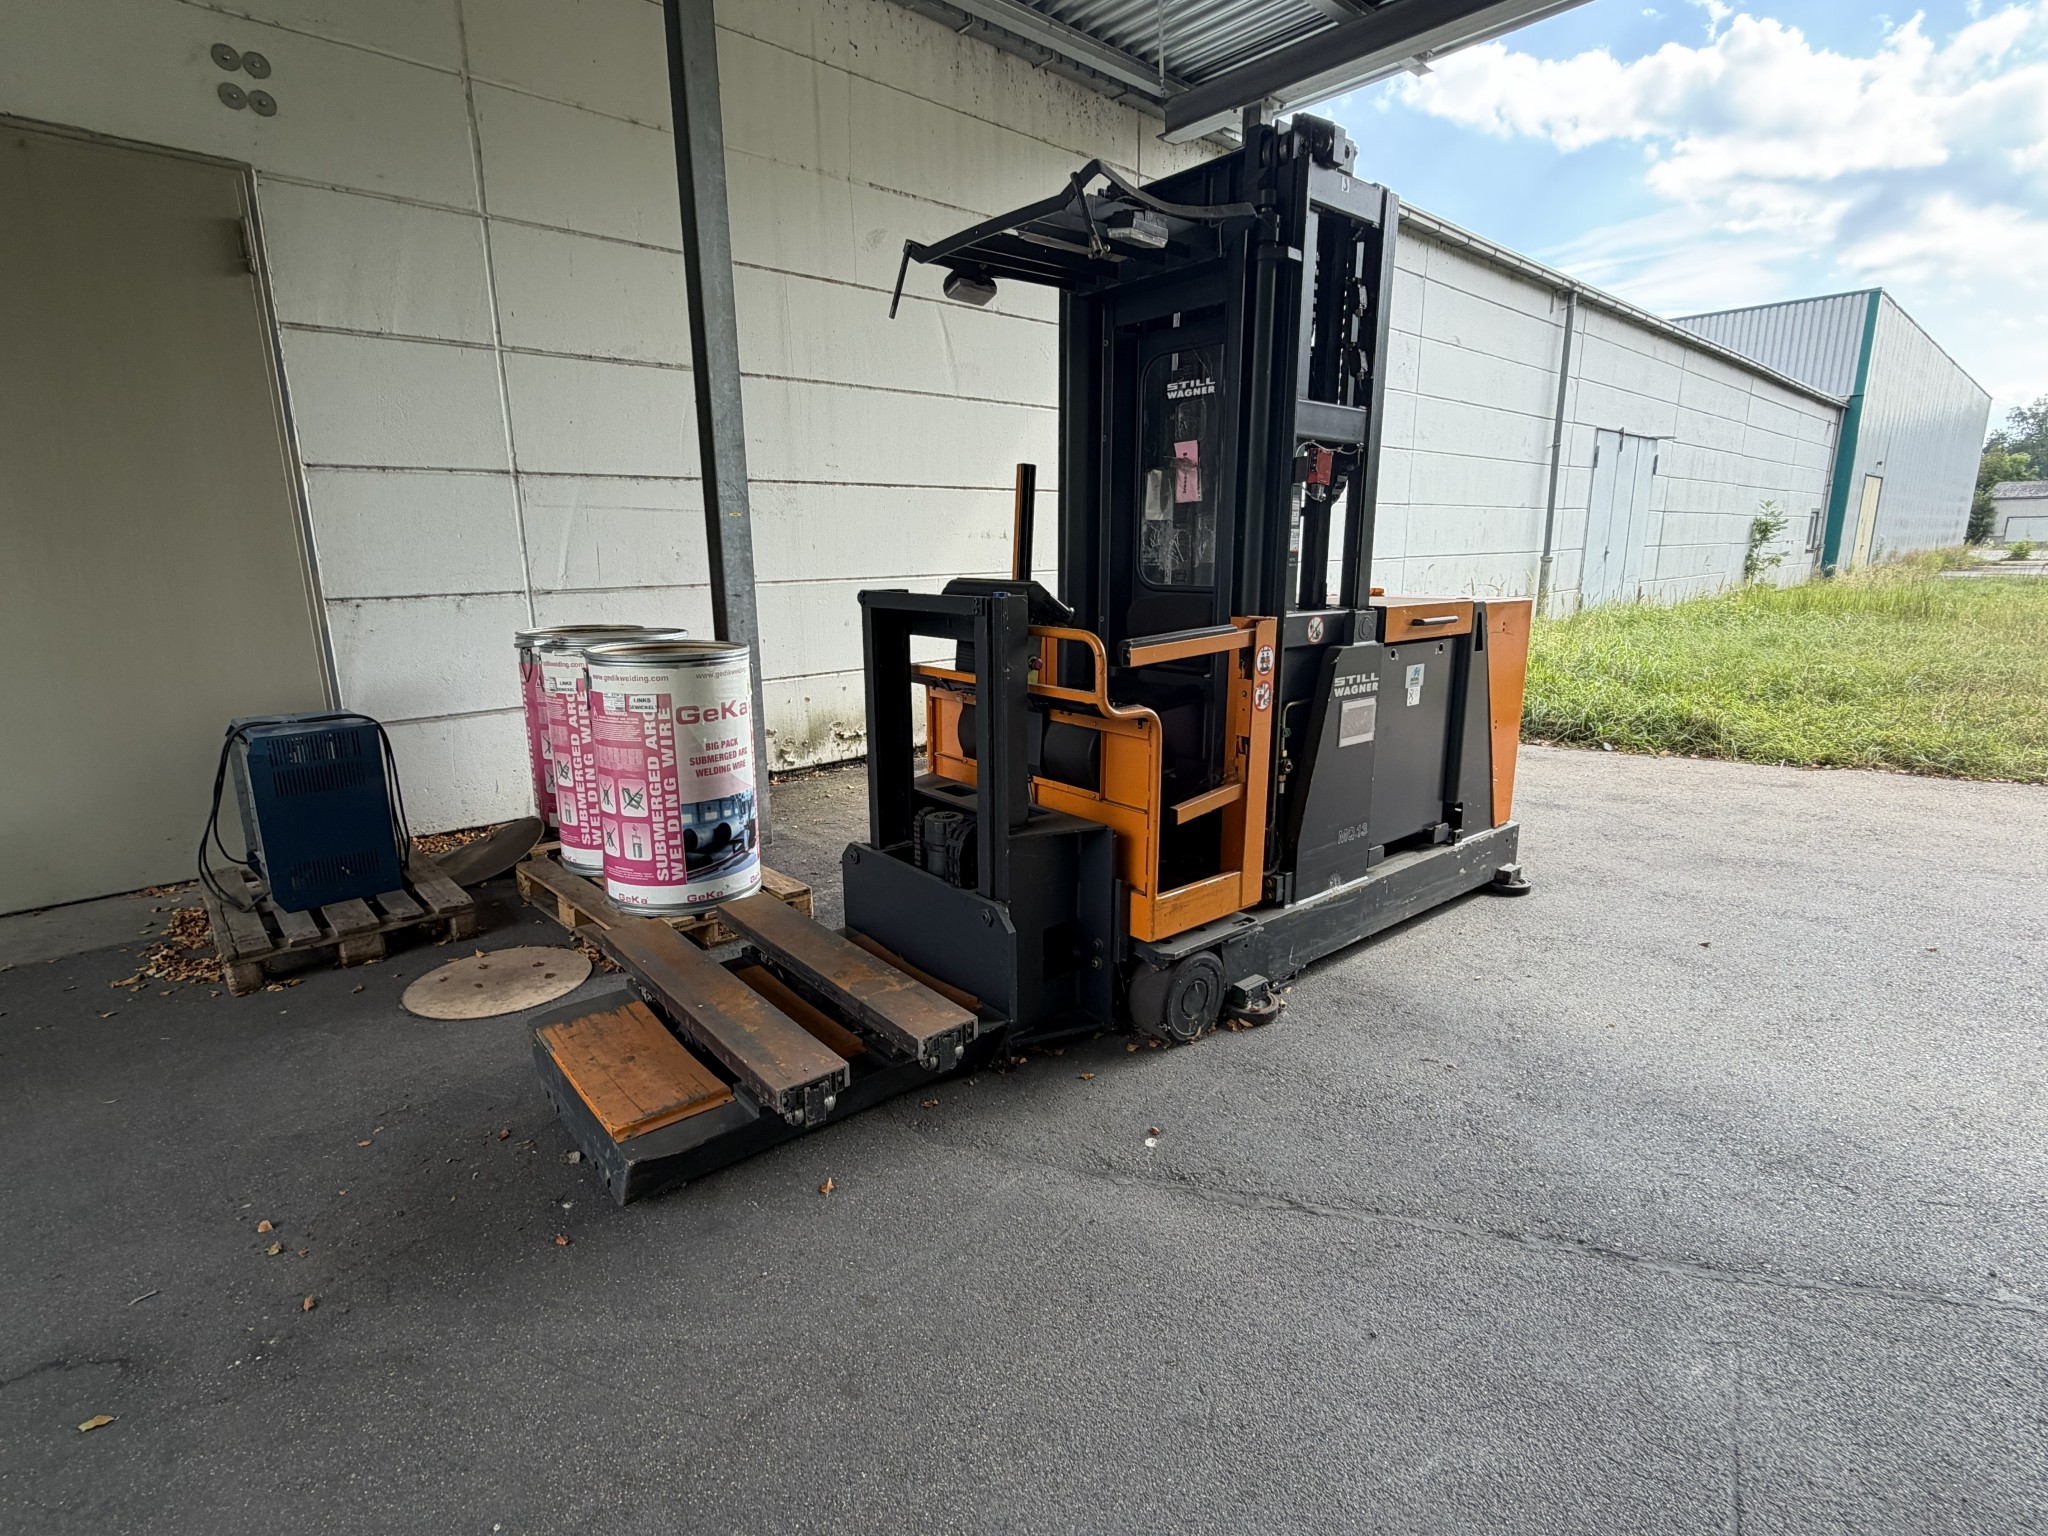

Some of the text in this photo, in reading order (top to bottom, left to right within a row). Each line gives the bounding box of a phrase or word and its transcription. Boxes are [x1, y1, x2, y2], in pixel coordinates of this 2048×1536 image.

[1167, 377, 1215, 391] STILL
[1167, 385, 1215, 399] WAGNER
[592, 673, 669, 684] www.gedikwelding.com
[1334, 672, 1379, 687] STILL
[1334, 682, 1379, 697] WAGNER
[675, 699, 748, 725] GeKa
[705, 738, 738, 751] BIG PACK
[689, 750, 737, 766] SUBMERGED
[566, 693, 591, 846] SUBMERGED ARC
[576, 691, 602, 846] WELDING WIRE
[695, 759, 746, 778] WELDING WIRE
[643, 712, 669, 881] SUBMERGED ARC
[658, 707, 685, 881] WELDING WIRE
[618, 893, 649, 905] GeKa
[687, 889, 725, 903] GeKa
